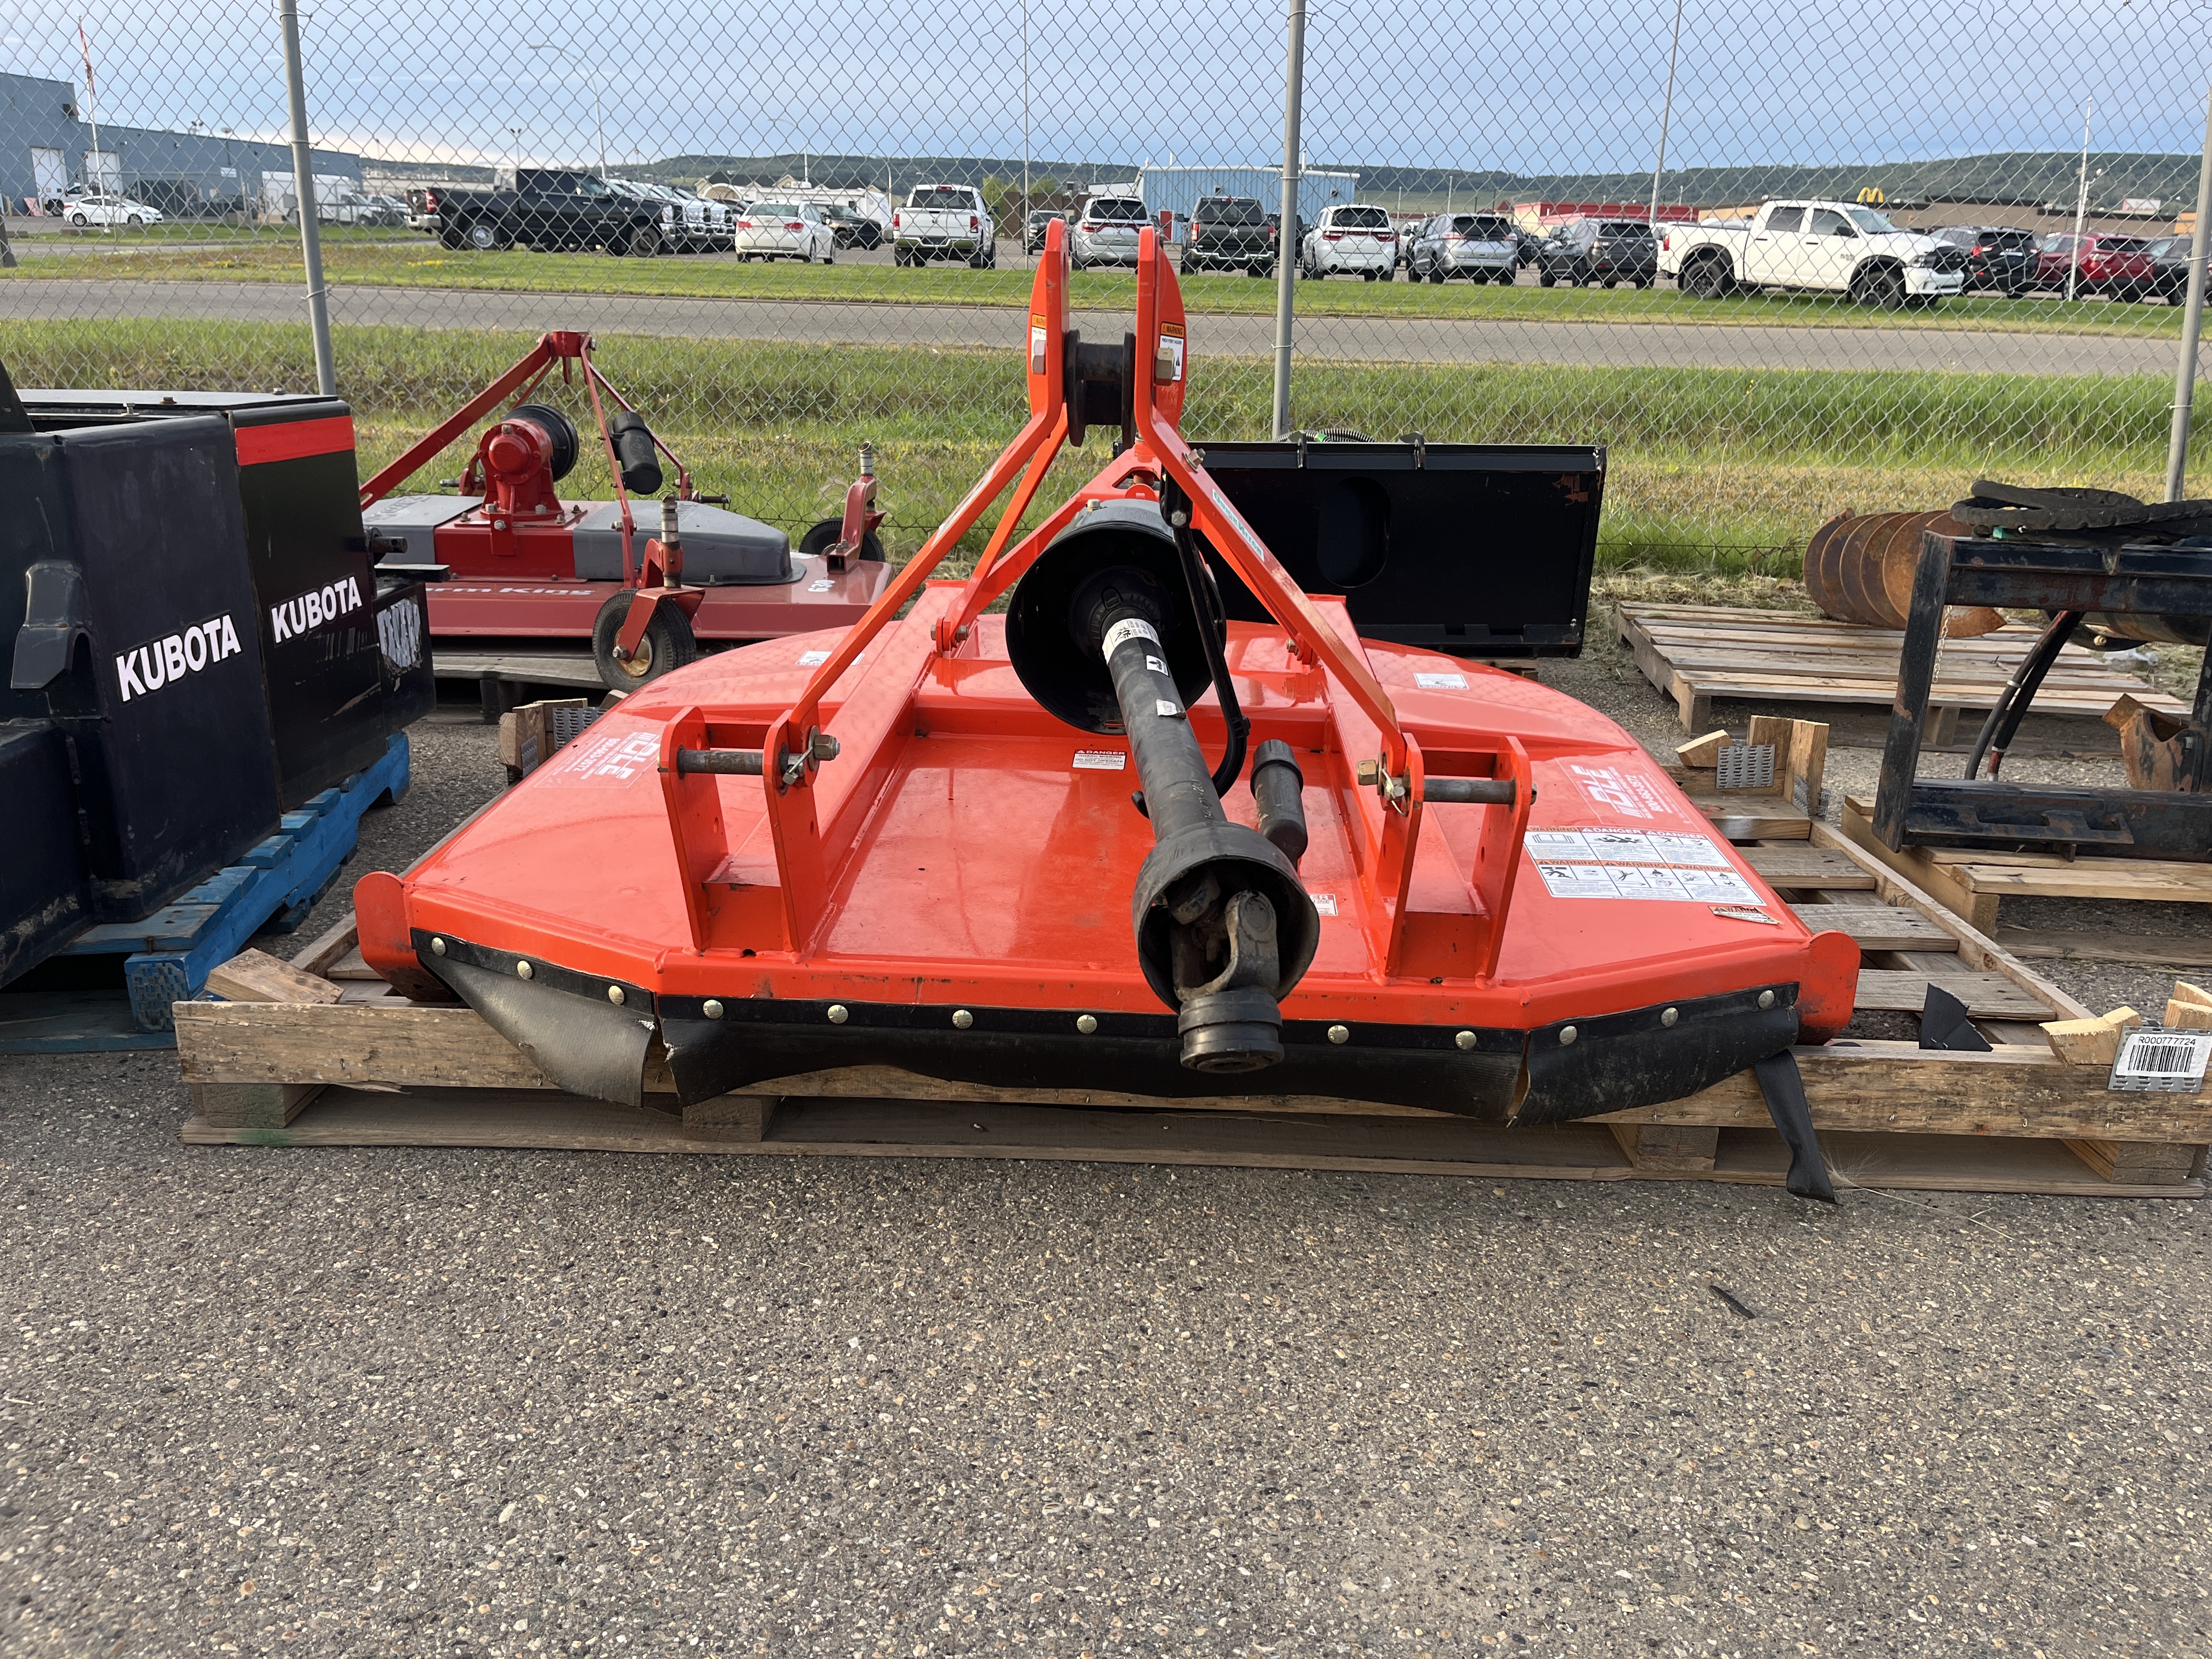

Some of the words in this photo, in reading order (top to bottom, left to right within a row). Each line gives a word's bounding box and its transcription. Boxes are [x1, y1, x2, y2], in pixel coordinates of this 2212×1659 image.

[1166, 325, 1183, 335] WARNING
[808, 580, 836, 592] 630
[272, 577, 362, 642] KUBOTA
[116, 615, 241, 702] KUBOTA
[573, 738, 620, 771] 800-663-3572
[1624, 774, 1663, 812] 800-663-3572
[1657, 831, 1705, 839] DANGER
[2139, 1036, 2196, 1046] R000777724
